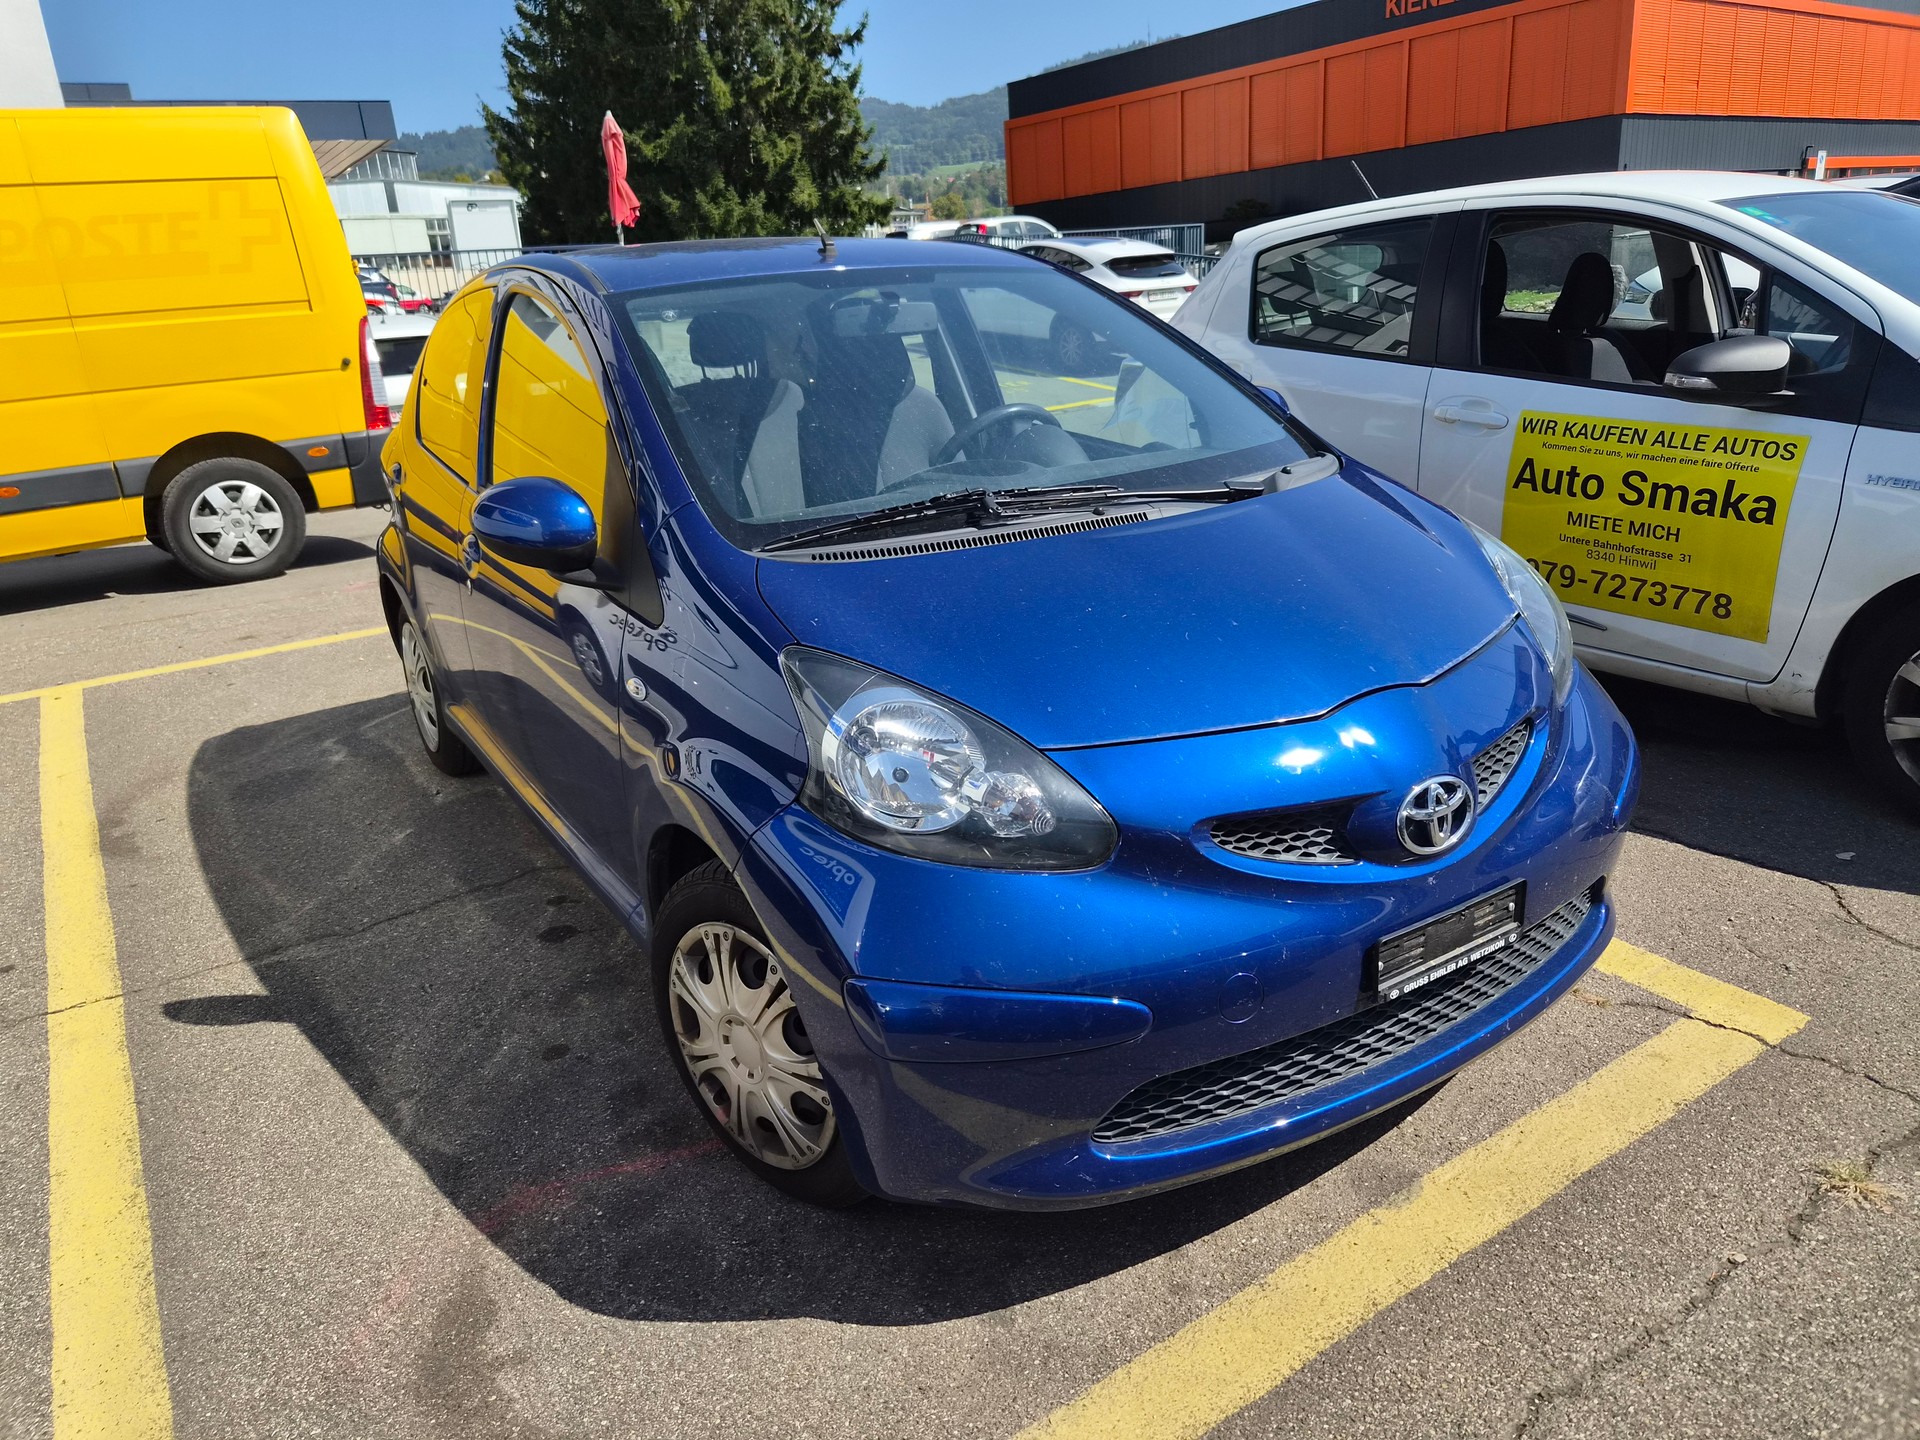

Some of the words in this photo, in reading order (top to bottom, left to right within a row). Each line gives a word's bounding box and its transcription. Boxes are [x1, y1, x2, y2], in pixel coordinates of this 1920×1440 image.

[1385, 0, 1458, 19] KIE
[1521, 416, 1558, 437] WIR
[1562, 421, 1648, 446] KAUFEN
[1650, 430, 1710, 453] ALLE
[1712, 436, 1799, 461] AUTOS
[1541, 440, 1578, 454] Kommen
[1578, 444, 1592, 455] Sie
[1593, 447, 1605, 456] zu
[1605, 448, 1624, 460] uns,
[1626, 449, 1640, 460] wir
[1640, 451, 1677, 465] machen
[1679, 455, 1699, 467] eine
[1701, 457, 1723, 469] faire
[1725, 460, 1760, 473] Offerte
[1512, 457, 1605, 501] Auto
[1617, 470, 1778, 526] Smaka
[1566, 510, 1624, 533] MIETE
[1628, 520, 1681, 543] MICH
[1559, 533, 1591, 547] Untere
[1593, 538, 1674, 561] Bahnhofstrasse
[1679, 554, 1692, 564] 31
[1586, 548, 1616, 564] 8340
[1619, 555, 1657, 571] Hinwil
[1403, 975, 1429, 994] GRUSS
[1429, 962, 1457, 981] EHRLER
[1457, 958, 1469, 970] AG
[1469, 938, 1505, 962] WETZIKON
